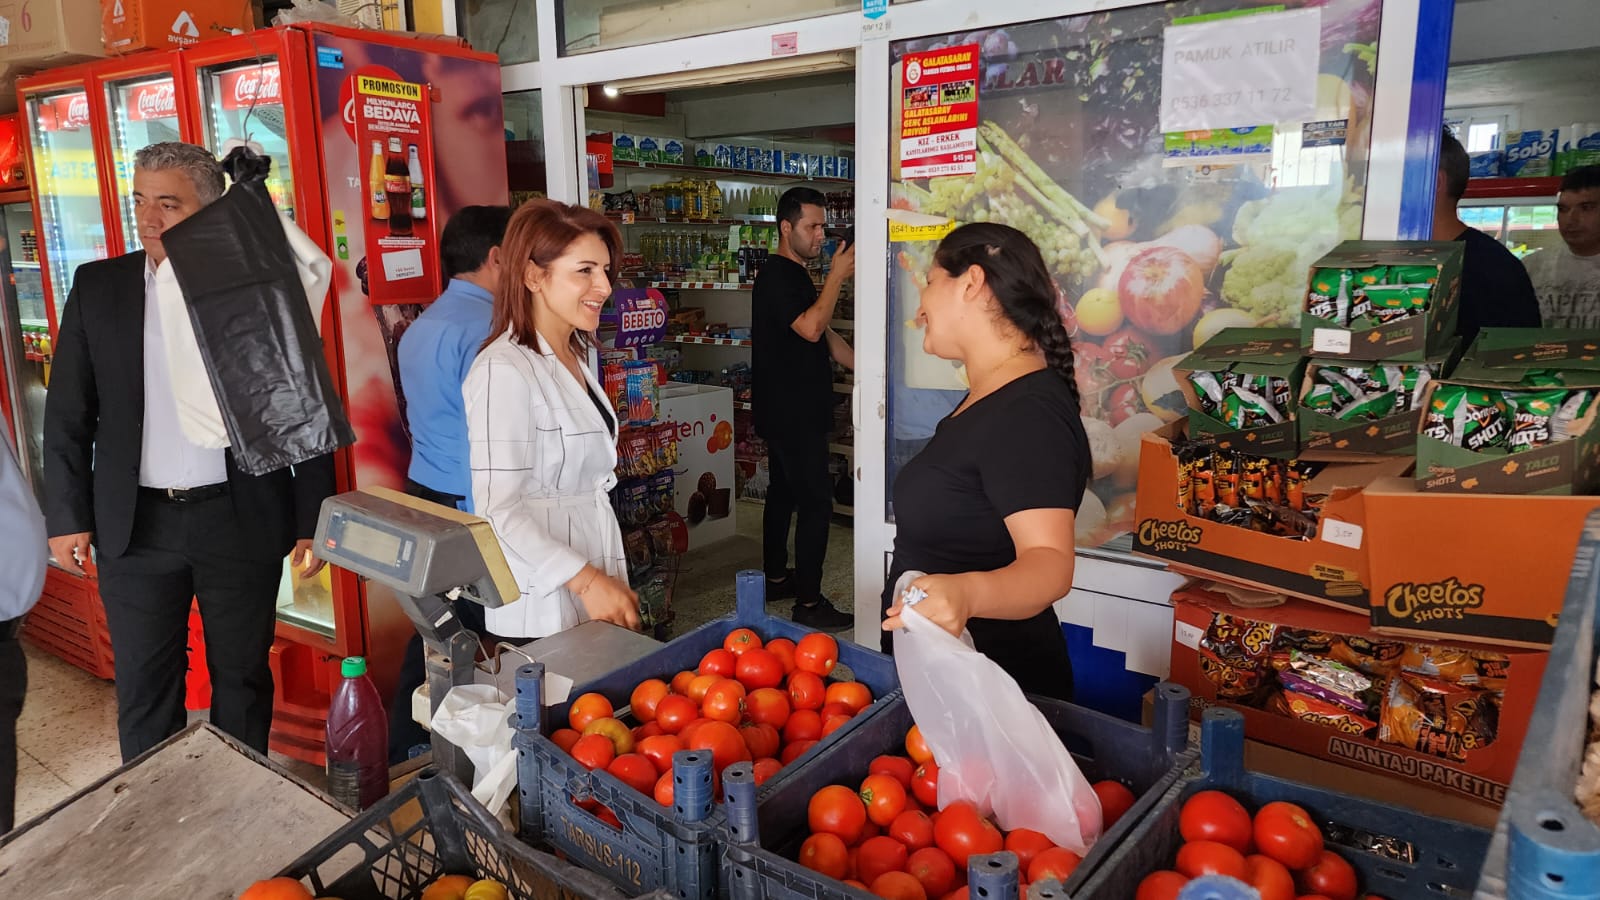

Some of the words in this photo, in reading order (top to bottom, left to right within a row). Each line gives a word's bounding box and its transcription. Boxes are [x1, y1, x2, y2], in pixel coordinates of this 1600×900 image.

[923, 52, 972, 68] GALATASARAY
[1174, 47, 1233, 64] PAMUK
[1241, 39, 1296, 57] ATILIR
[363, 78, 418, 97] PROMOSYON
[1214, 92, 1241, 106] 337
[1272, 88, 1292, 102] 72
[363, 104, 421, 123] BEDAVA
[904, 106, 952, 118] GALATASARAY
[918, 138, 929, 146] KIZ
[936, 133, 960, 143] ERKEK
[1507, 139, 1553, 164] Solo
[623, 310, 665, 331] BEBETO
[1509, 428, 1548, 446] HOTS
[1525, 456, 1560, 469] TACO
[1426, 474, 1456, 488] SHOTS
[1139, 518, 1201, 546] Cheetos
[1154, 541, 1188, 551] SHOTS
[1386, 578, 1483, 618] Cheetos
[1413, 608, 1464, 623] SHOTS
[1331, 738, 1416, 776] AVANTAJ
[560, 815, 641, 886] TARSUS-112
